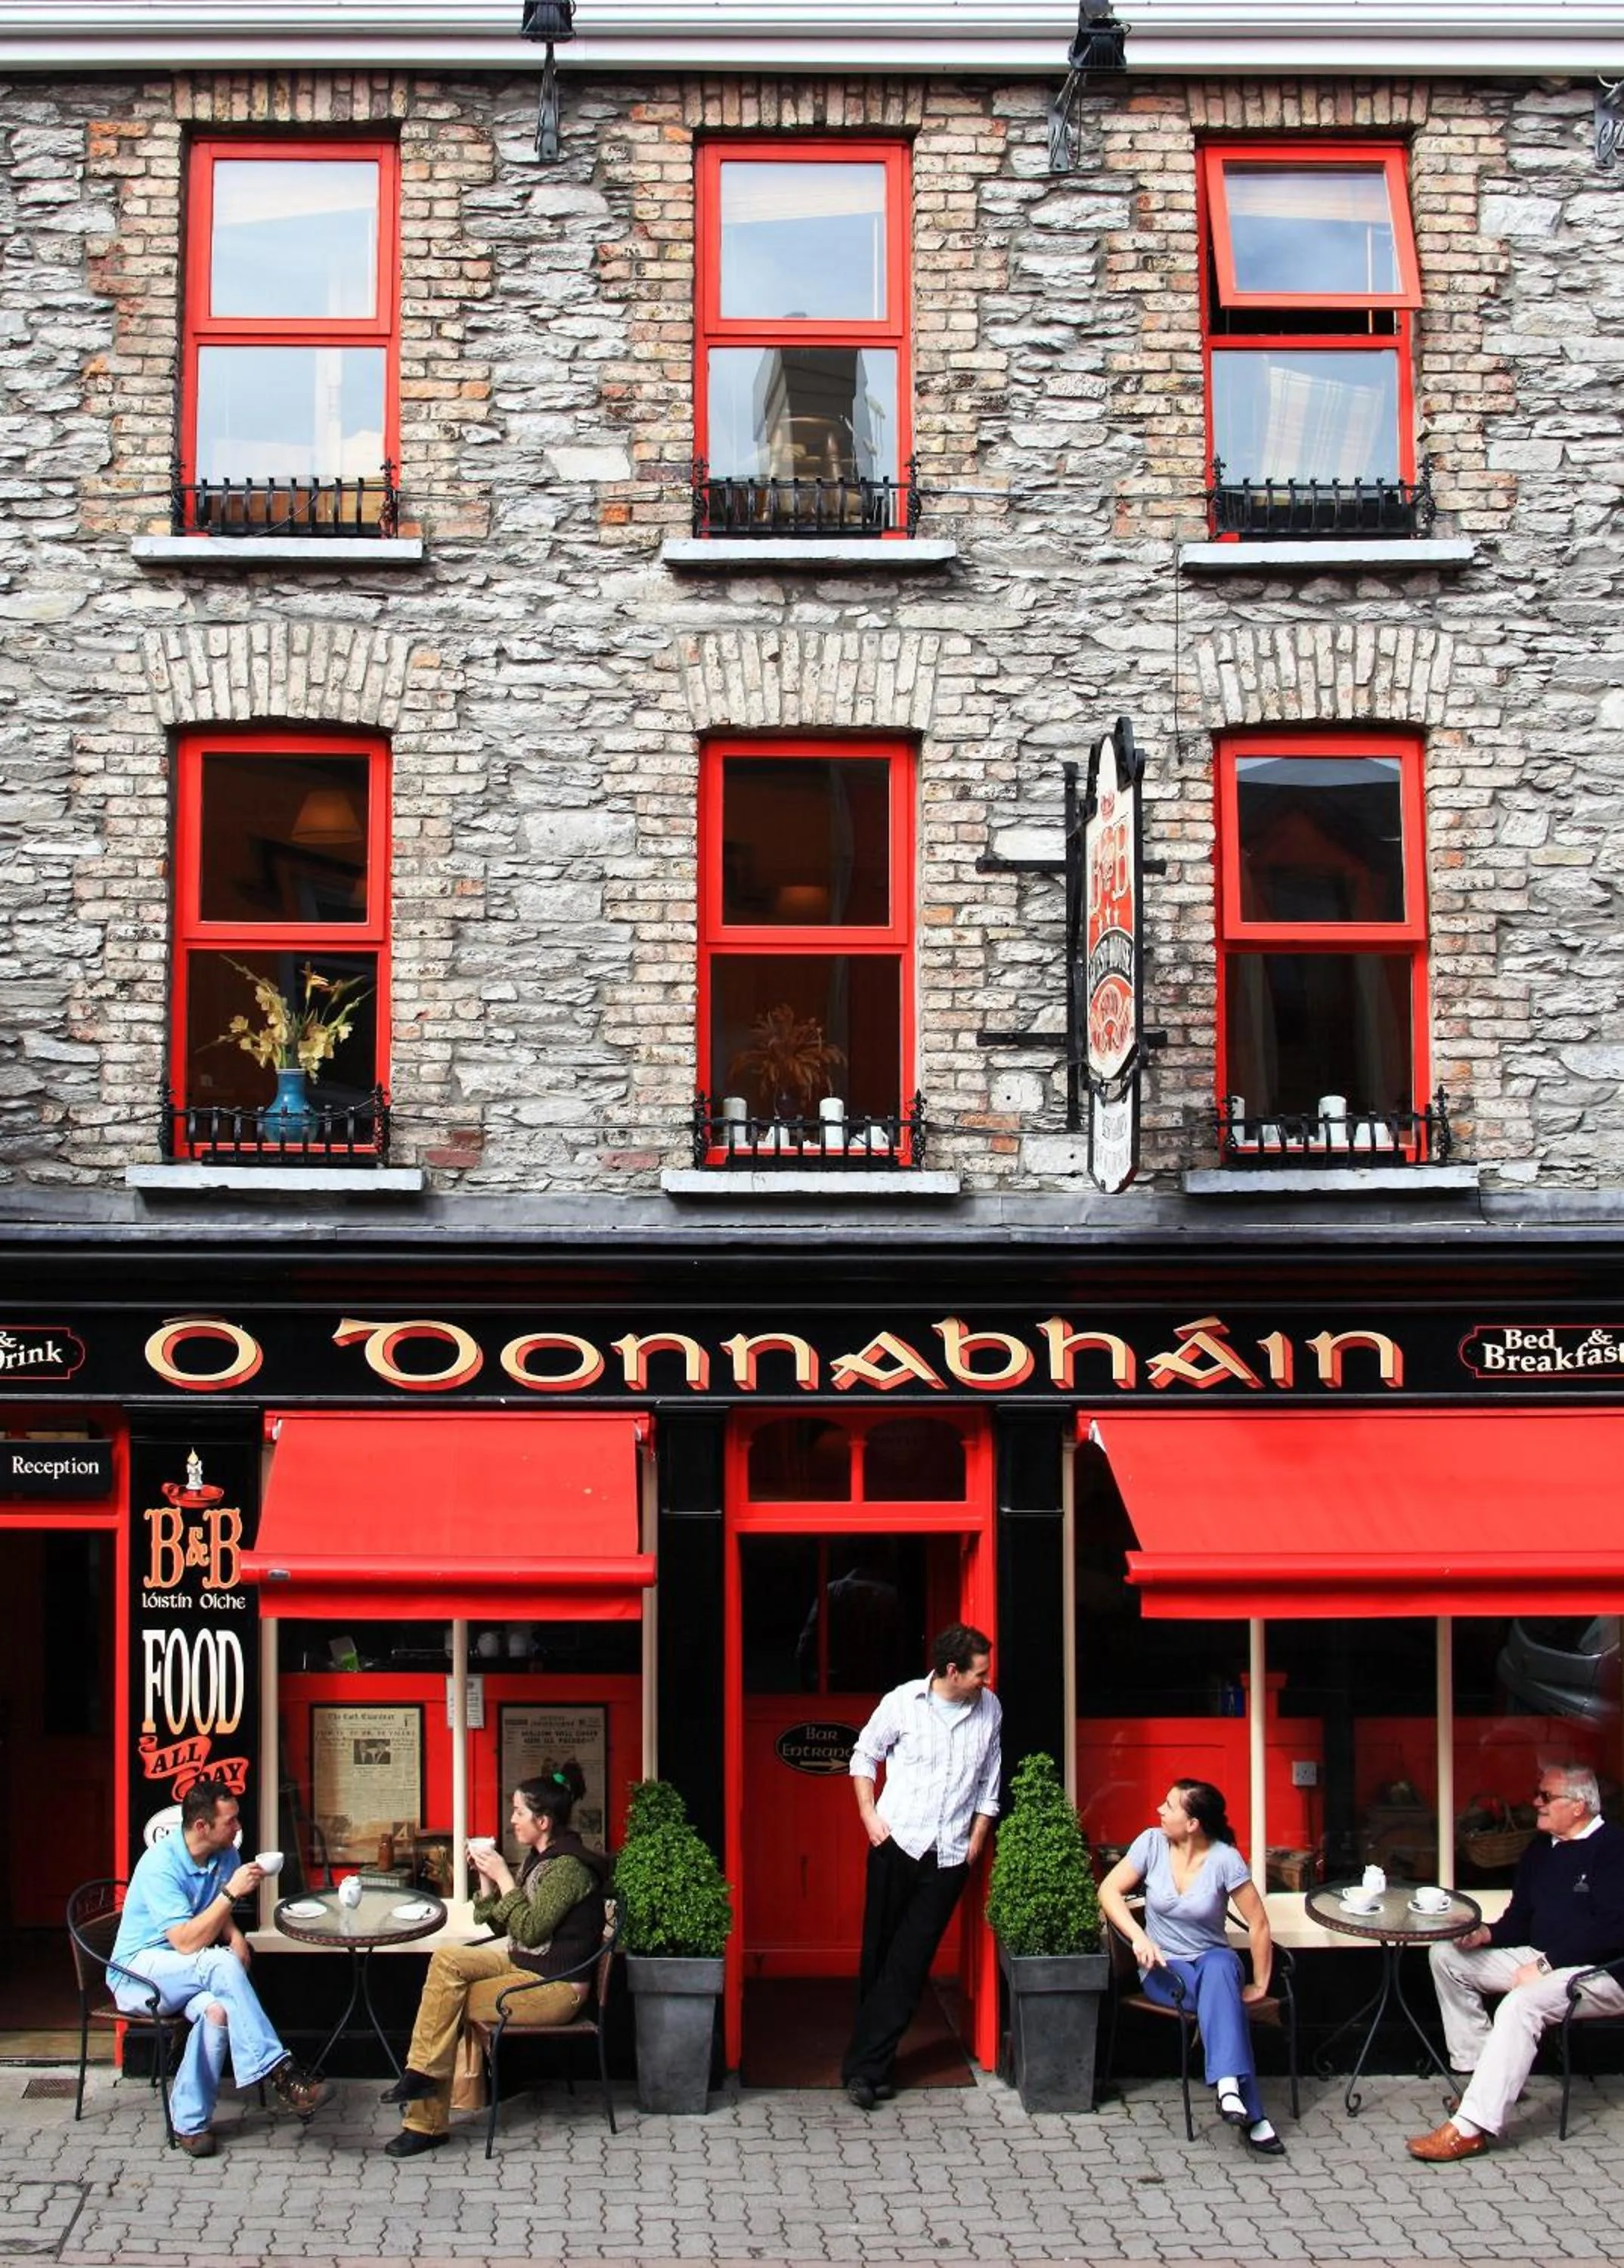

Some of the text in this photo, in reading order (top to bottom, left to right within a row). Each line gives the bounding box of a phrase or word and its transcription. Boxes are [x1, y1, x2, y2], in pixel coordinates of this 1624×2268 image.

[1503, 1328, 1614, 1349] Bed &
[12, 1455, 100, 1479] Reception
[144, 1507, 243, 1588] B&B
[142, 1628, 244, 1735] FOOD
[806, 1726, 838, 1740] Bar
[151, 1742, 202, 1774] ALL
[783, 1743, 851, 1758] Entranc
